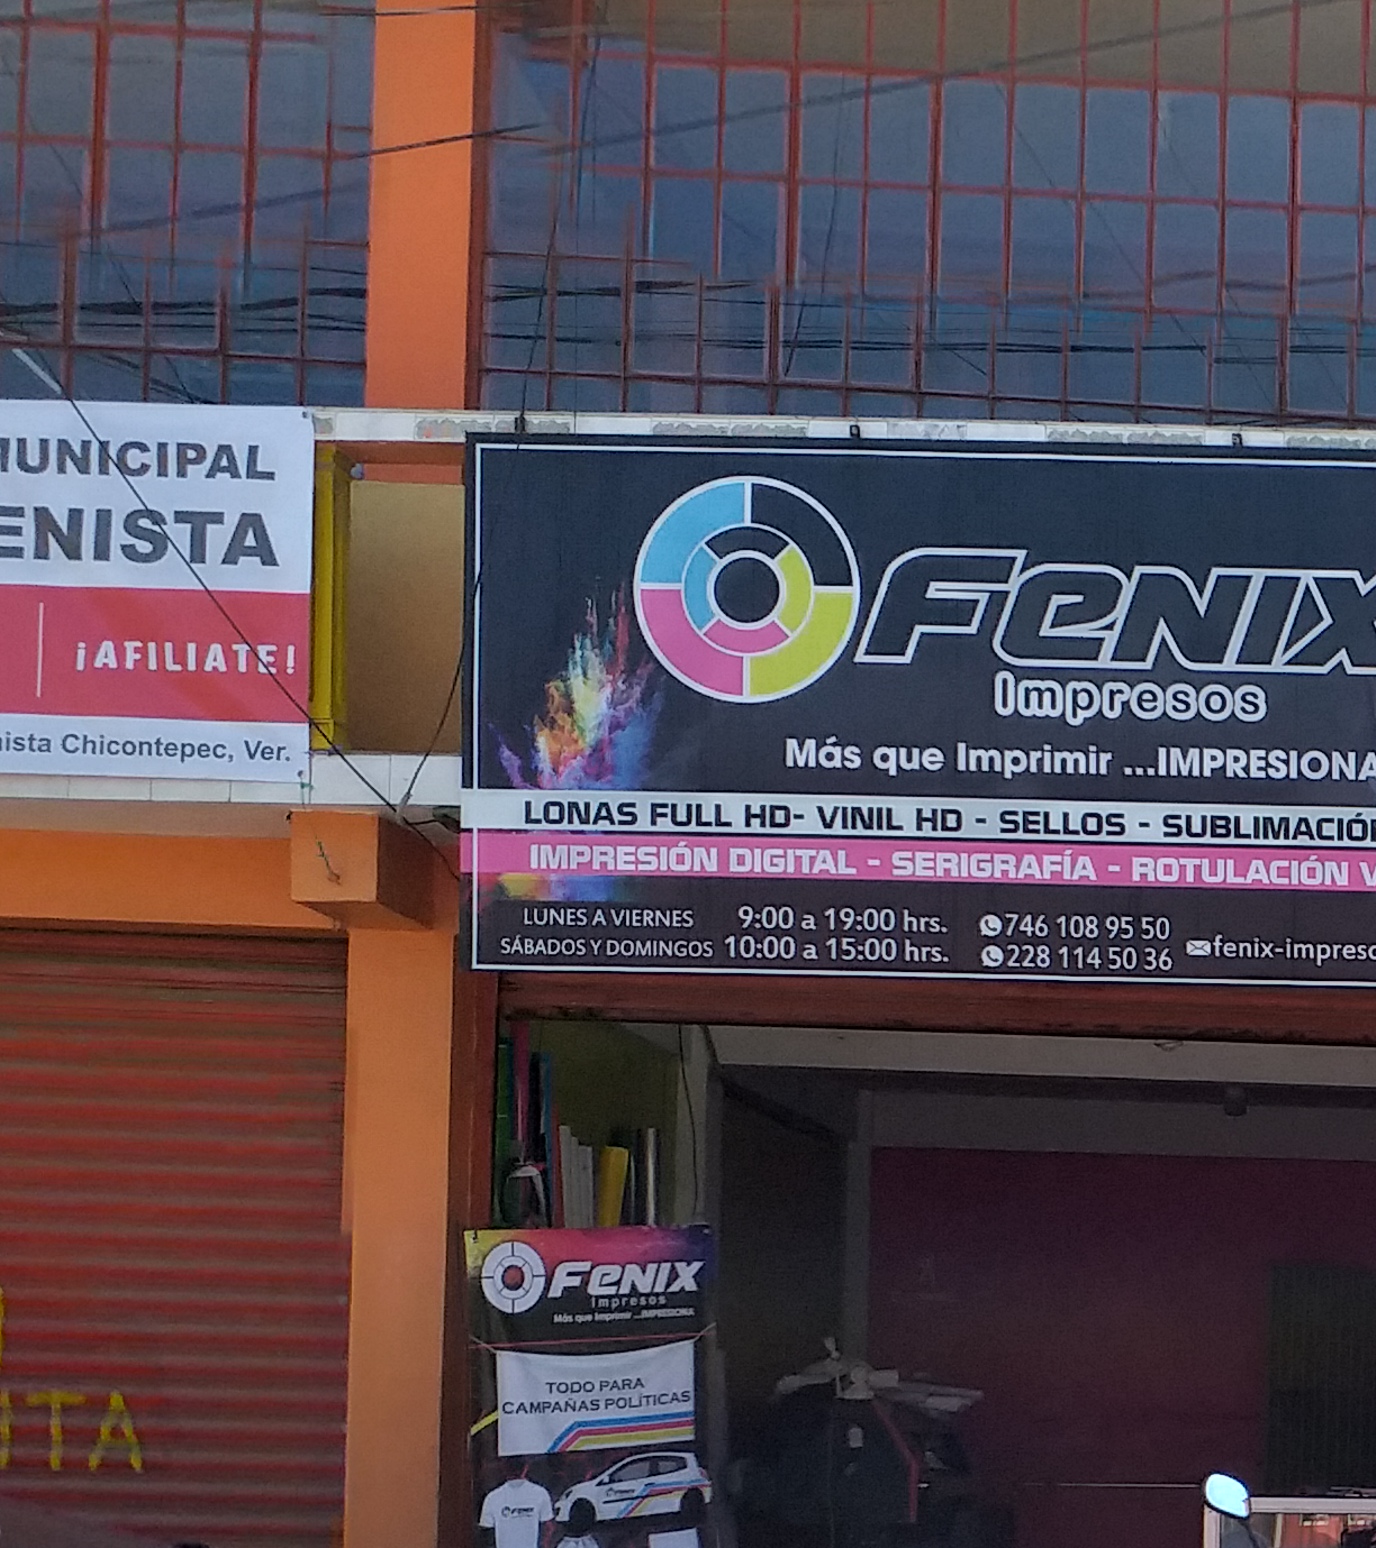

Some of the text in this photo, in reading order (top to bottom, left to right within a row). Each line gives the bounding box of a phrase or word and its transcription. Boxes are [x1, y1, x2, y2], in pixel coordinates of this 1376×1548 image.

[0, 436, 276, 481] UNICIPAL
[75, 640, 297, 675] ¡AFILIATE!
[993, 669, 1268, 726] Impresos
[0, 731, 291, 764] ista Chicontepec, Ver.
[785, 736, 861, 771] Más
[872, 747, 944, 778] que
[956, 742, 1112, 779] Imprimir
[524, 799, 638, 827] LONAS
[649, 802, 732, 829] FULL
[816, 805, 901, 832] VINIL
[915, 807, 963, 833] HD
[999, 808, 1126, 838] SELLOS
[529, 841, 718, 875] IMPRESIÓN
[728, 848, 857, 876] DIGITAL
[891, 849, 1098, 882] SERIGRAFÍA
[1131, 852, 1349, 886] ROTULACIÓN
[523, 905, 948, 933] LUNES A VIERNES 9:00 a 19:00 hrs.
[1005, 913, 1170, 940] 746 108 95 50
[500, 934, 950, 964] SÁBADOS Y DOMINGOS 10:00 a 15:00 hrs.
[1007, 944, 1173, 971] 228 114 50 36
[501, 1390, 691, 1415] CAMPAÑAS POLÍTICAS
[546, 1378, 645, 1395] TODO PARA
